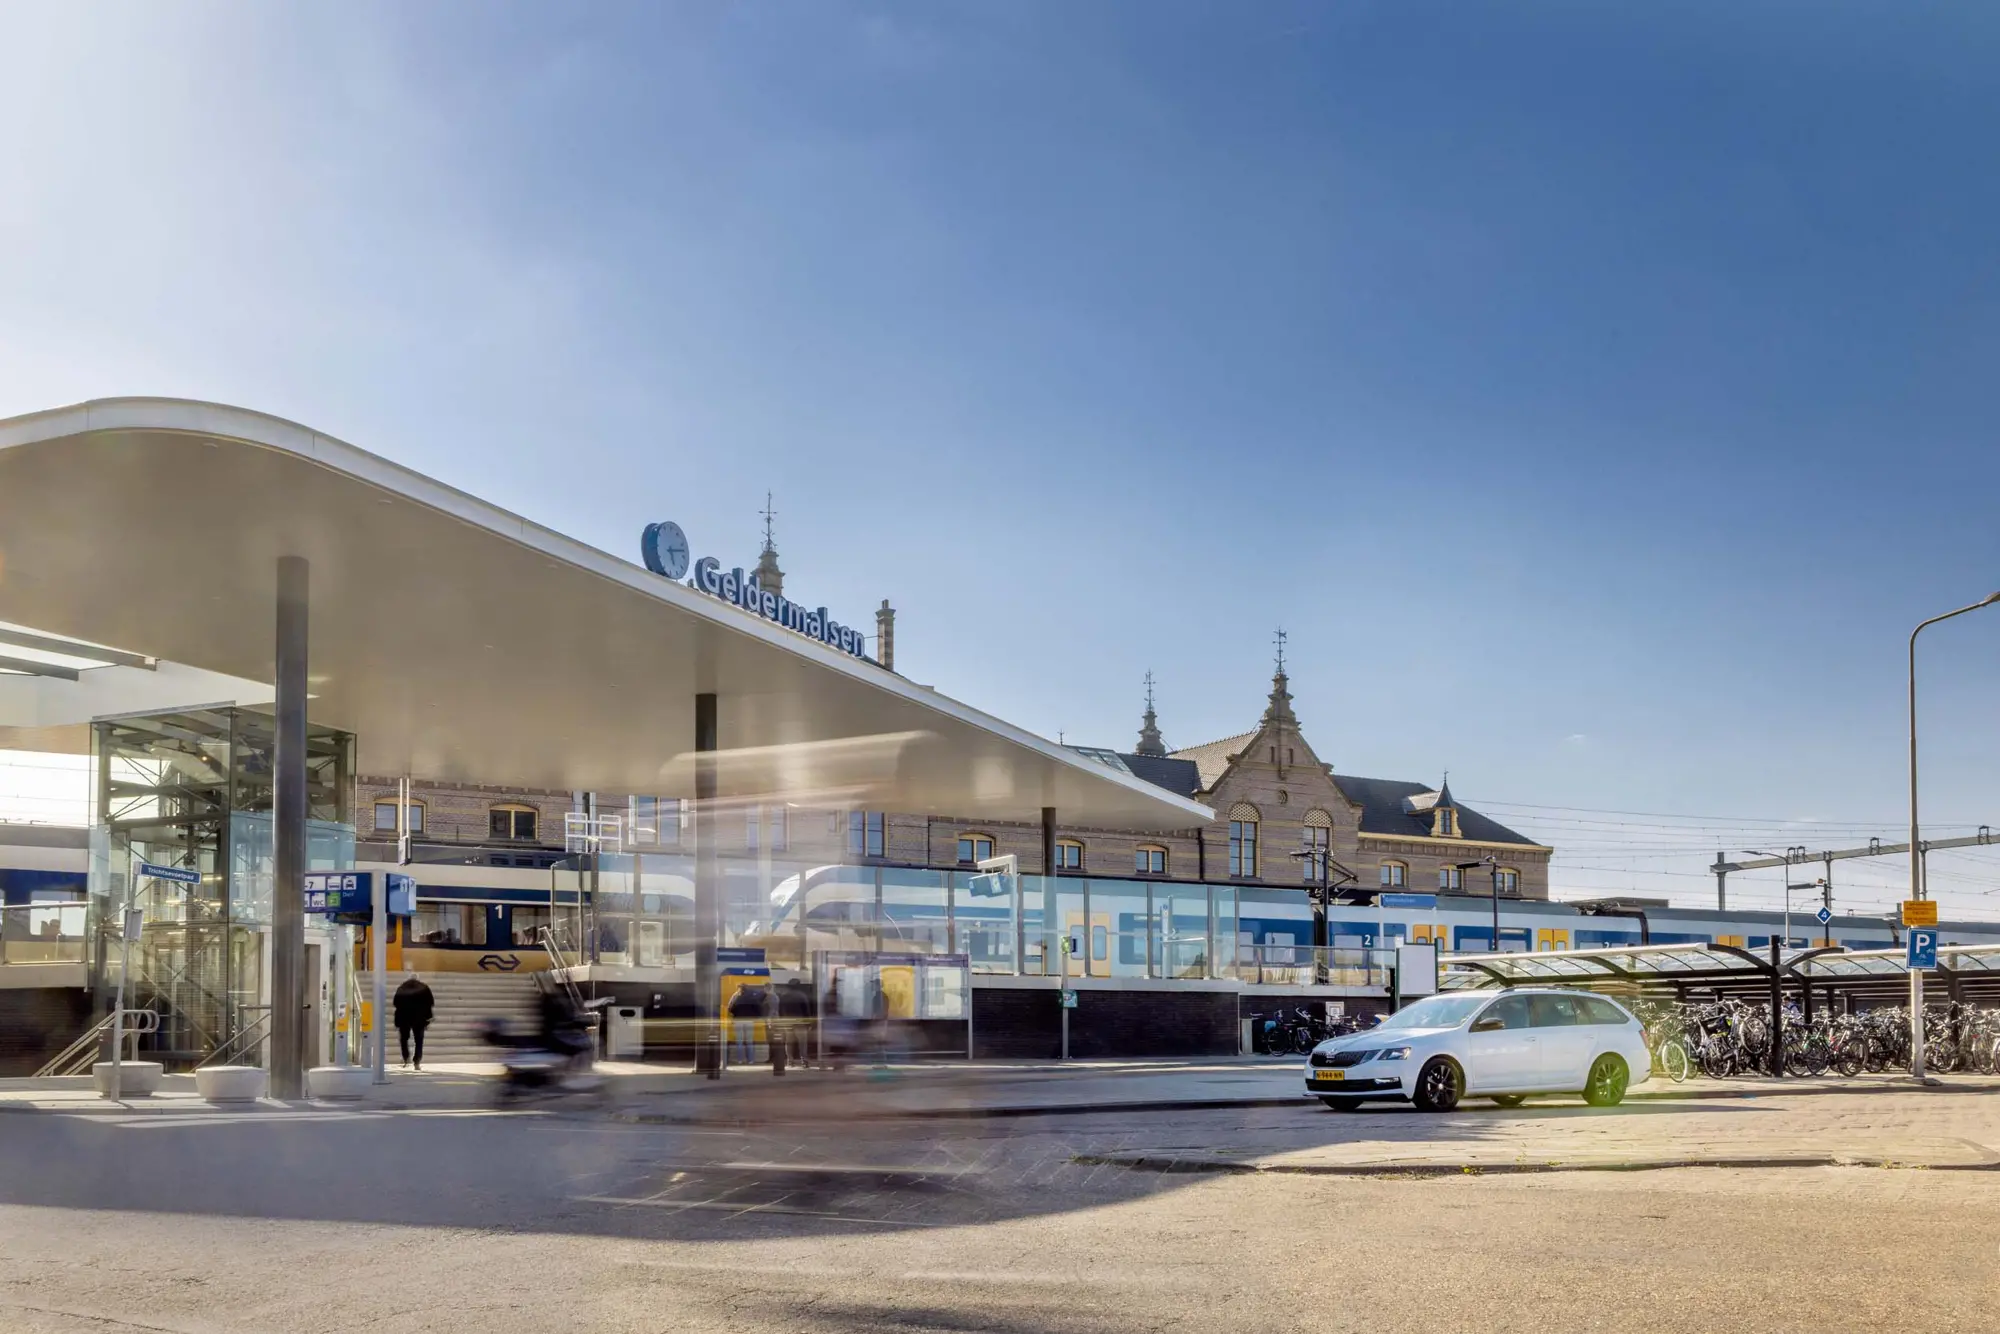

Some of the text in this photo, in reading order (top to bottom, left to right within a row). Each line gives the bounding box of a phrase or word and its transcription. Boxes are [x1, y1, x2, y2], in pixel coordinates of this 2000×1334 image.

[695, 556, 865, 657] Geldermalsen
[495, 904, 503, 919] 1
[1820, 910, 1828, 918] 4
[1364, 934, 1371, 945] 2
[1915, 934, 1930, 953] P
